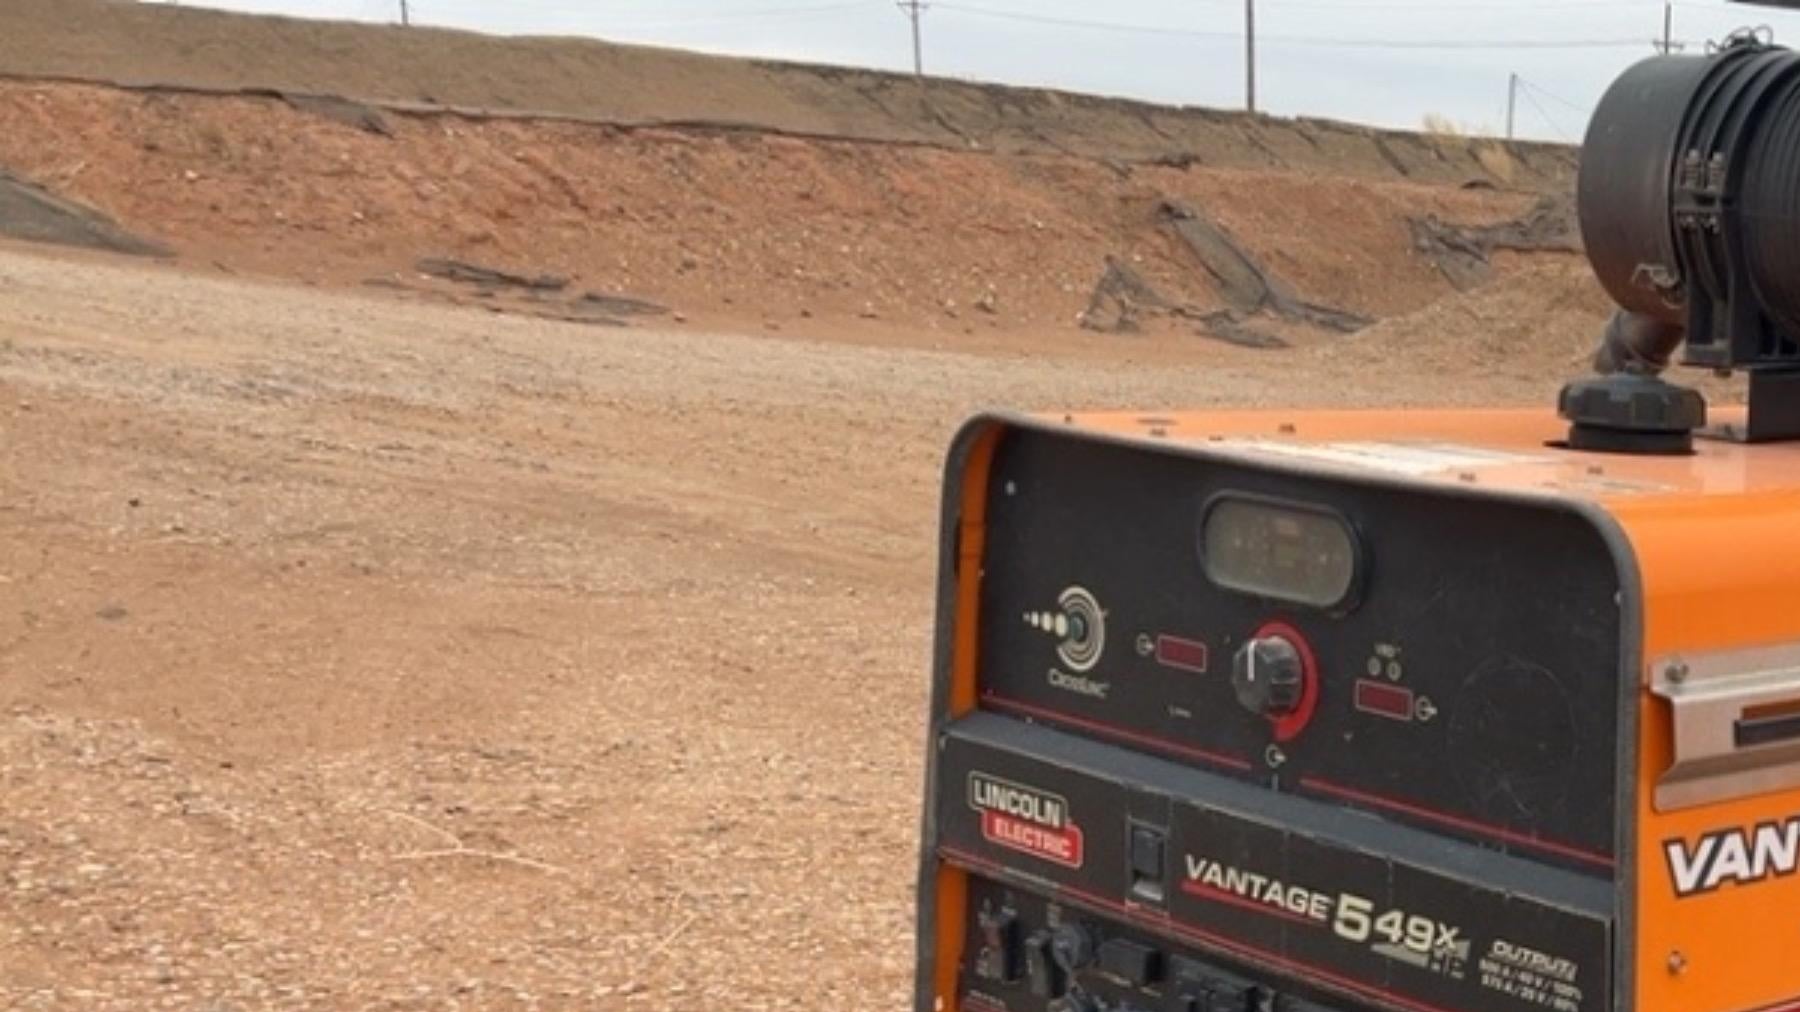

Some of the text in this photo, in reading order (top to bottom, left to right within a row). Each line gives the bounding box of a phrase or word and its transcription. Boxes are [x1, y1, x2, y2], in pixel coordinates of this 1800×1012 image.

[973, 778, 1061, 828] LINCOLN
[994, 817, 1072, 858] ELECTRIC
[1184, 853, 1334, 920] VANTAGE
